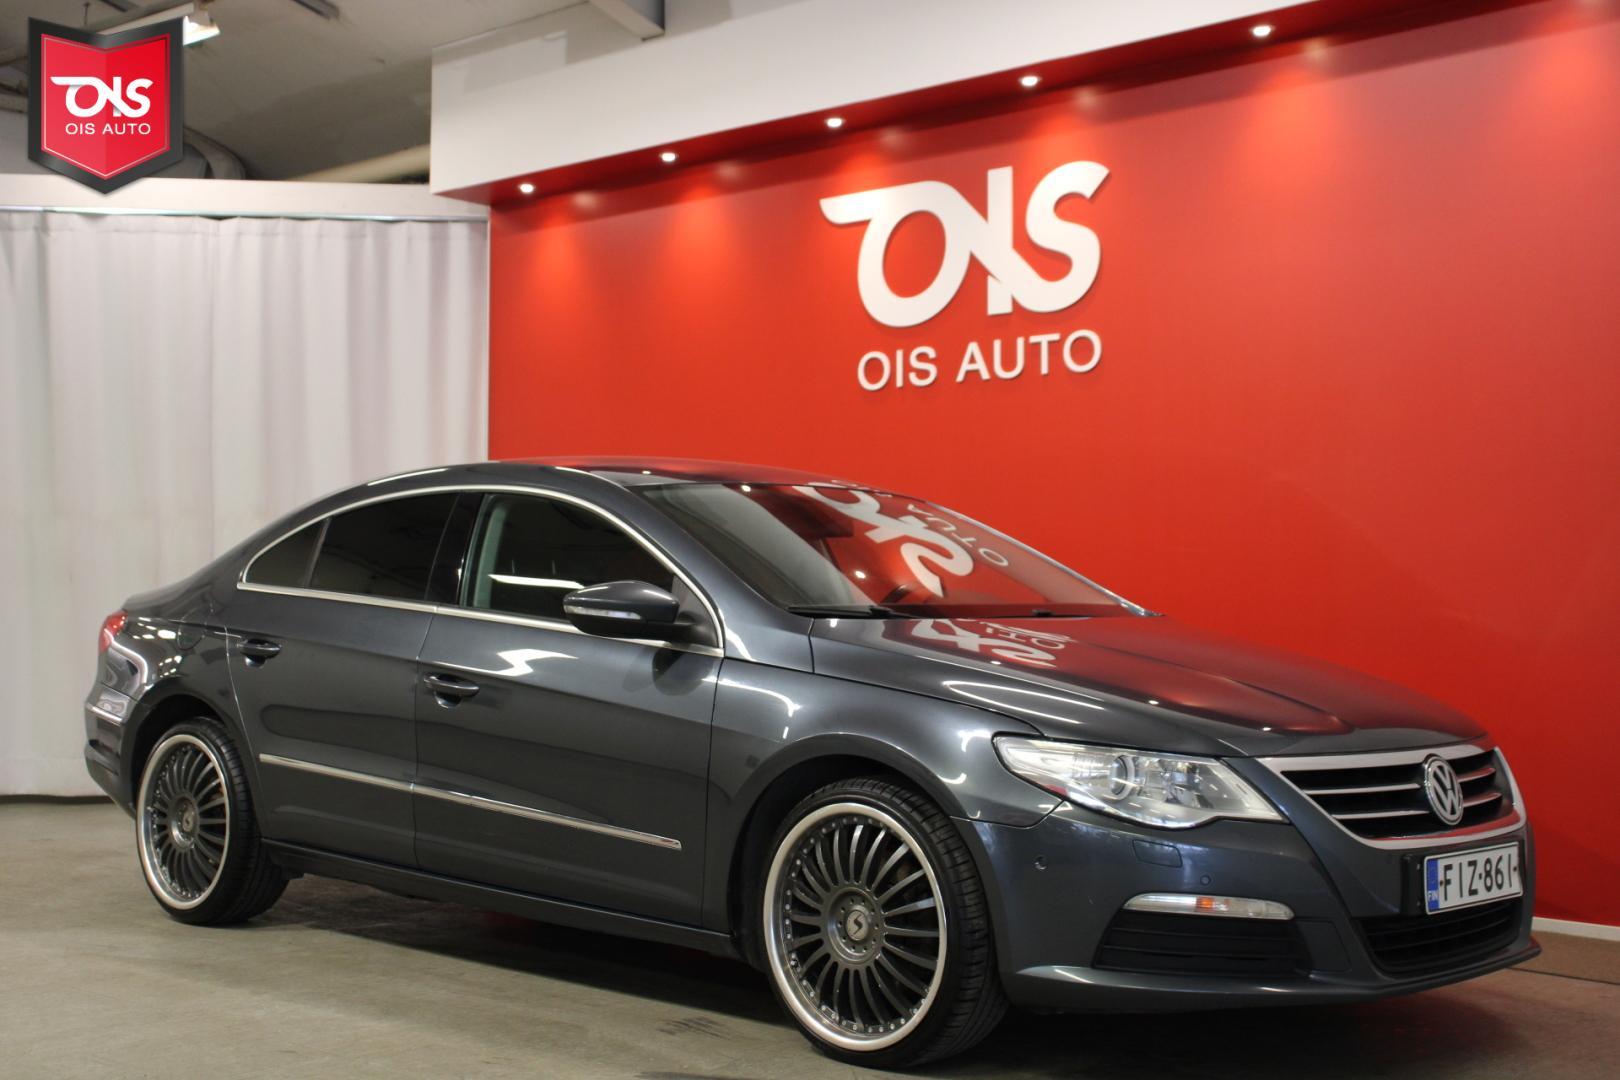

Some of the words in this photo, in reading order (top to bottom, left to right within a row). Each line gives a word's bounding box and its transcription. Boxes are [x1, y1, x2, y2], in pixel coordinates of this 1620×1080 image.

[857, 346, 938, 391] OIS
[955, 329, 1102, 382] AUTO
[1443, 853, 1512, 901] FIZ-861
